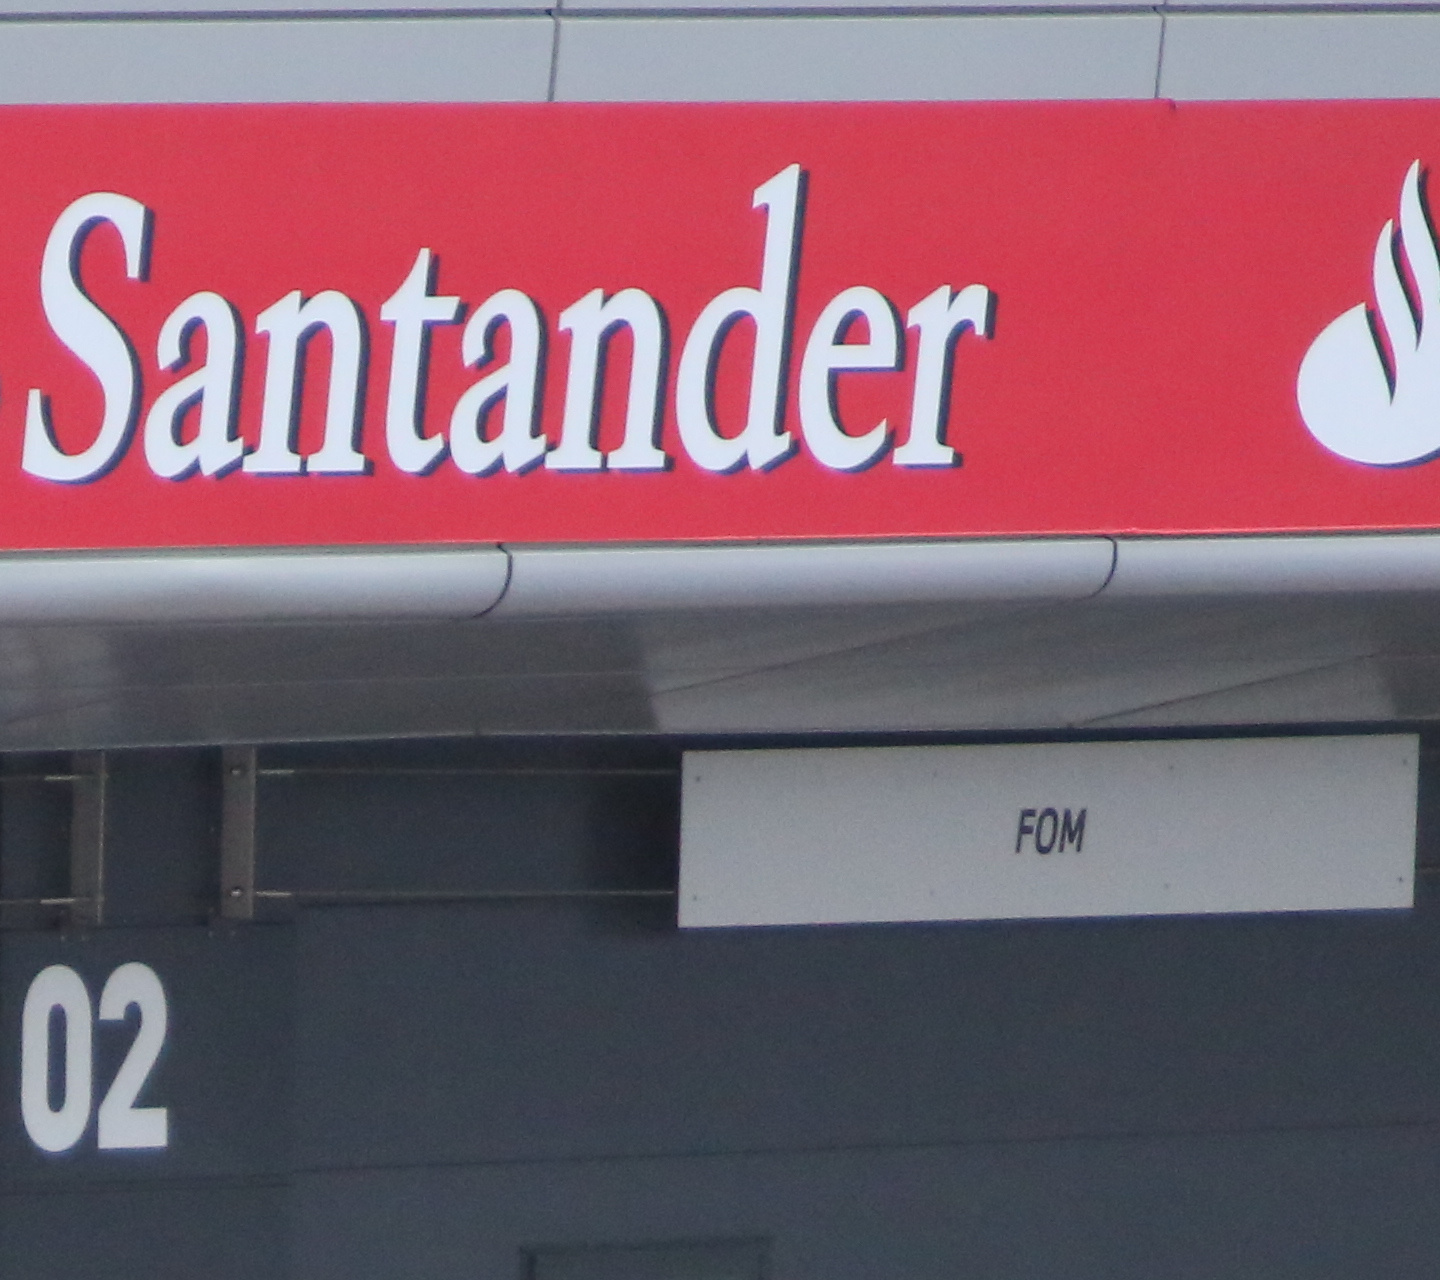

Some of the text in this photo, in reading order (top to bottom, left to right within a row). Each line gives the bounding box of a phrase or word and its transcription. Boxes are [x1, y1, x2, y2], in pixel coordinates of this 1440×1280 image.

[20, 164, 990, 481] Santander
[1015, 807, 1087, 855] FOM
[20, 962, 169, 1153] 02
